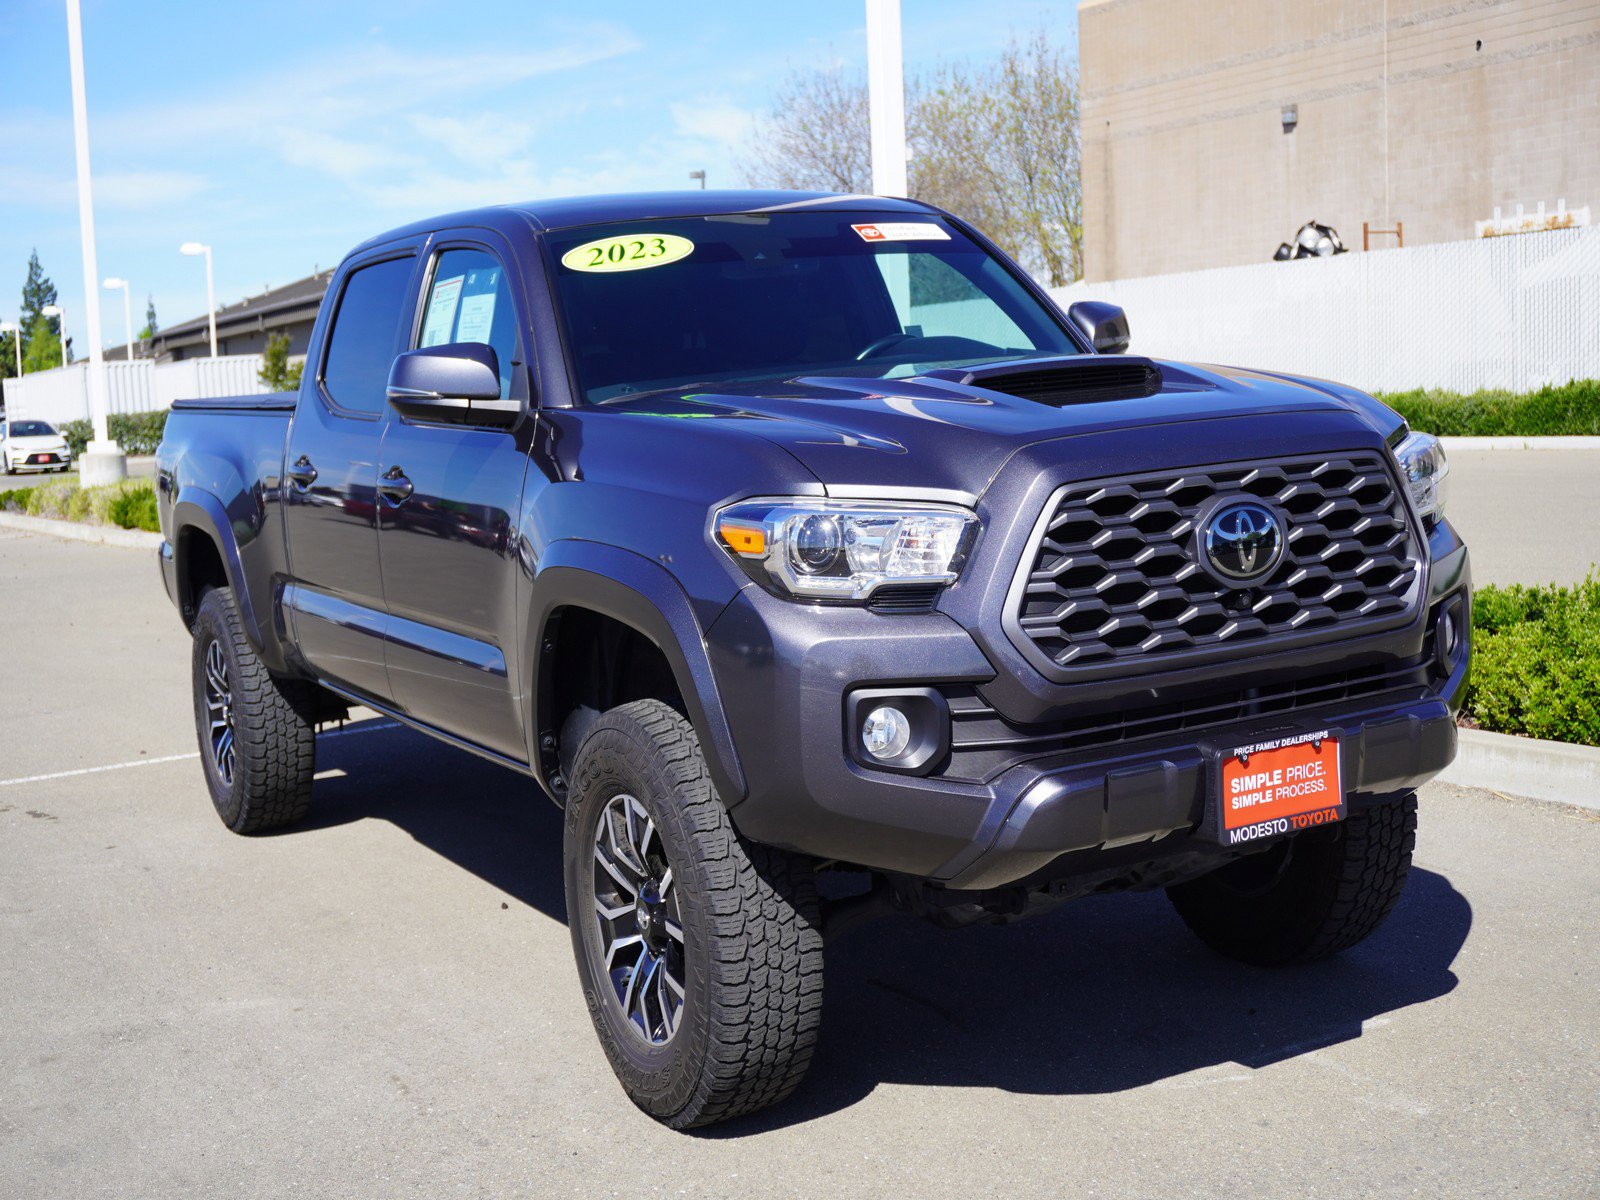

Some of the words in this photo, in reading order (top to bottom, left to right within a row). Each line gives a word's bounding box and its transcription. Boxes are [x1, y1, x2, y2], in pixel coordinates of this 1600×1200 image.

[586, 238, 666, 267] 2023
[1233, 744, 1255, 757] PRICE
[1255, 740, 1281, 752] FAMILY
[1281, 730, 1329, 747] DEALERSHIPS
[1230, 769, 1282, 793] SIMPLE
[1286, 761, 1326, 783] PRICE.
[1231, 789, 1273, 810] SIMPLE
[1275, 779, 1327, 801] PROCESS.
[1230, 818, 1288, 844] MODESTO
[1290, 808, 1339, 829] TOYOTA
